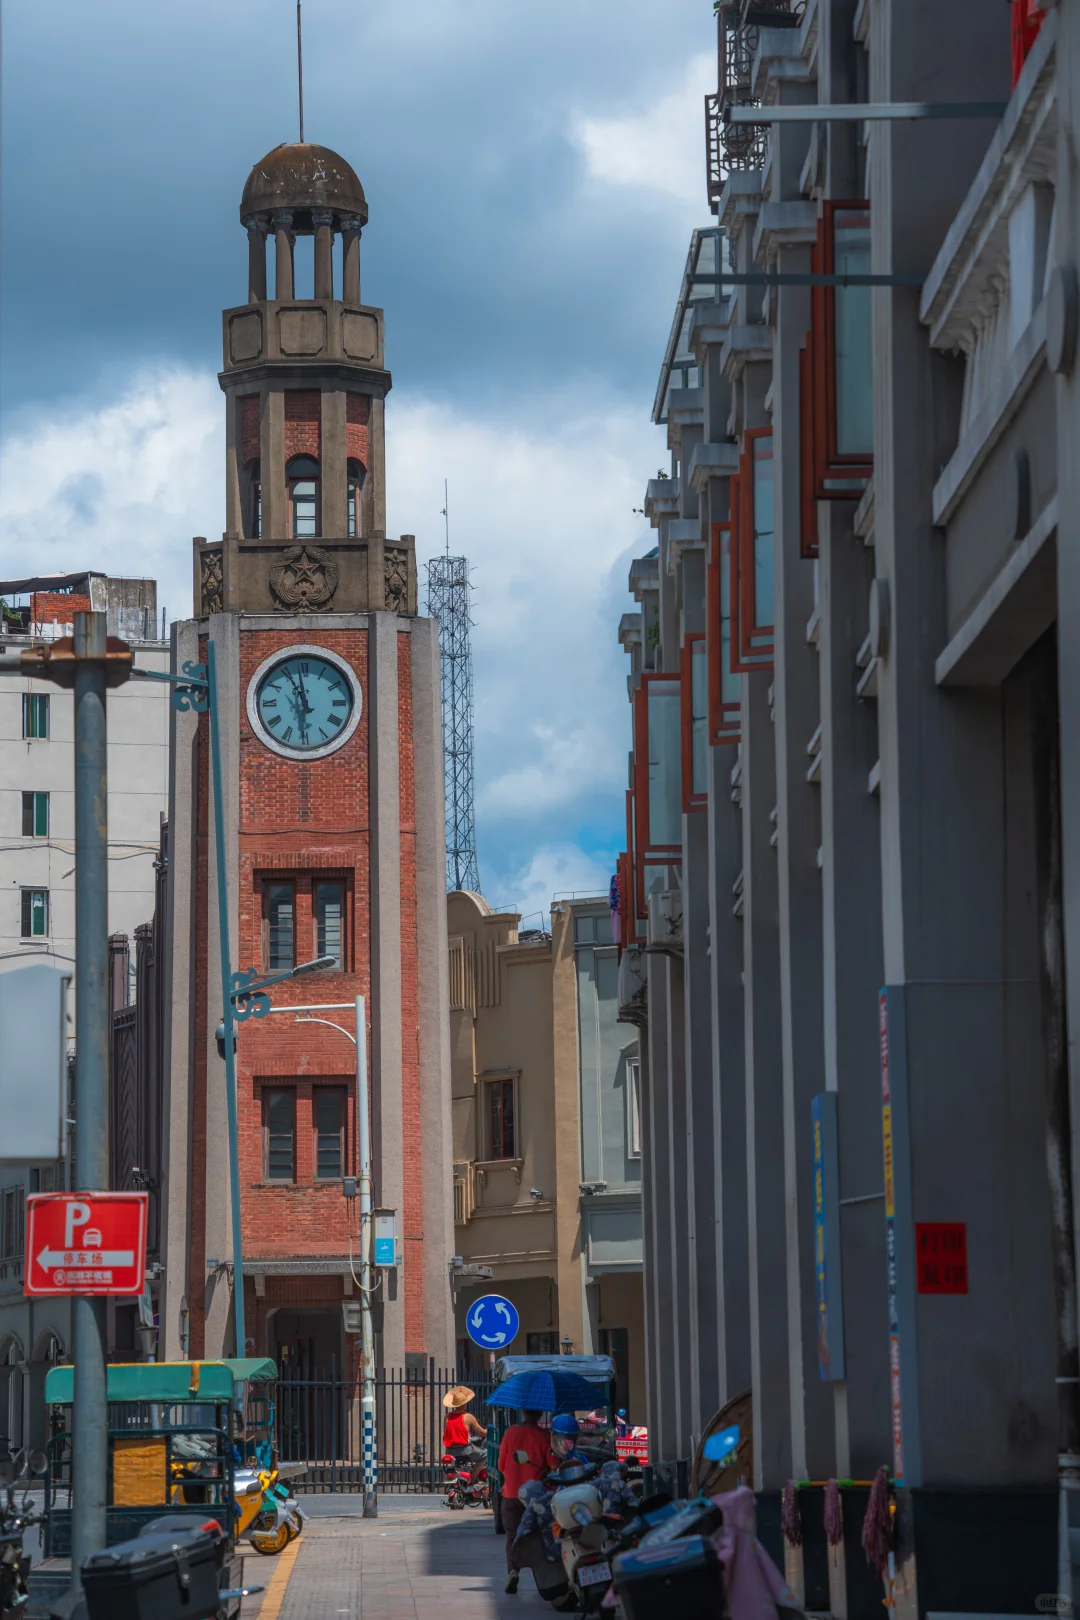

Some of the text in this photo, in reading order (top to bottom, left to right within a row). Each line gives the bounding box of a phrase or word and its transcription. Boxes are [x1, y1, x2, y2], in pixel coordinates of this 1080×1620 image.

[65, 1202, 91, 1248] P
[63, 1252, 103, 1265] 停车场
